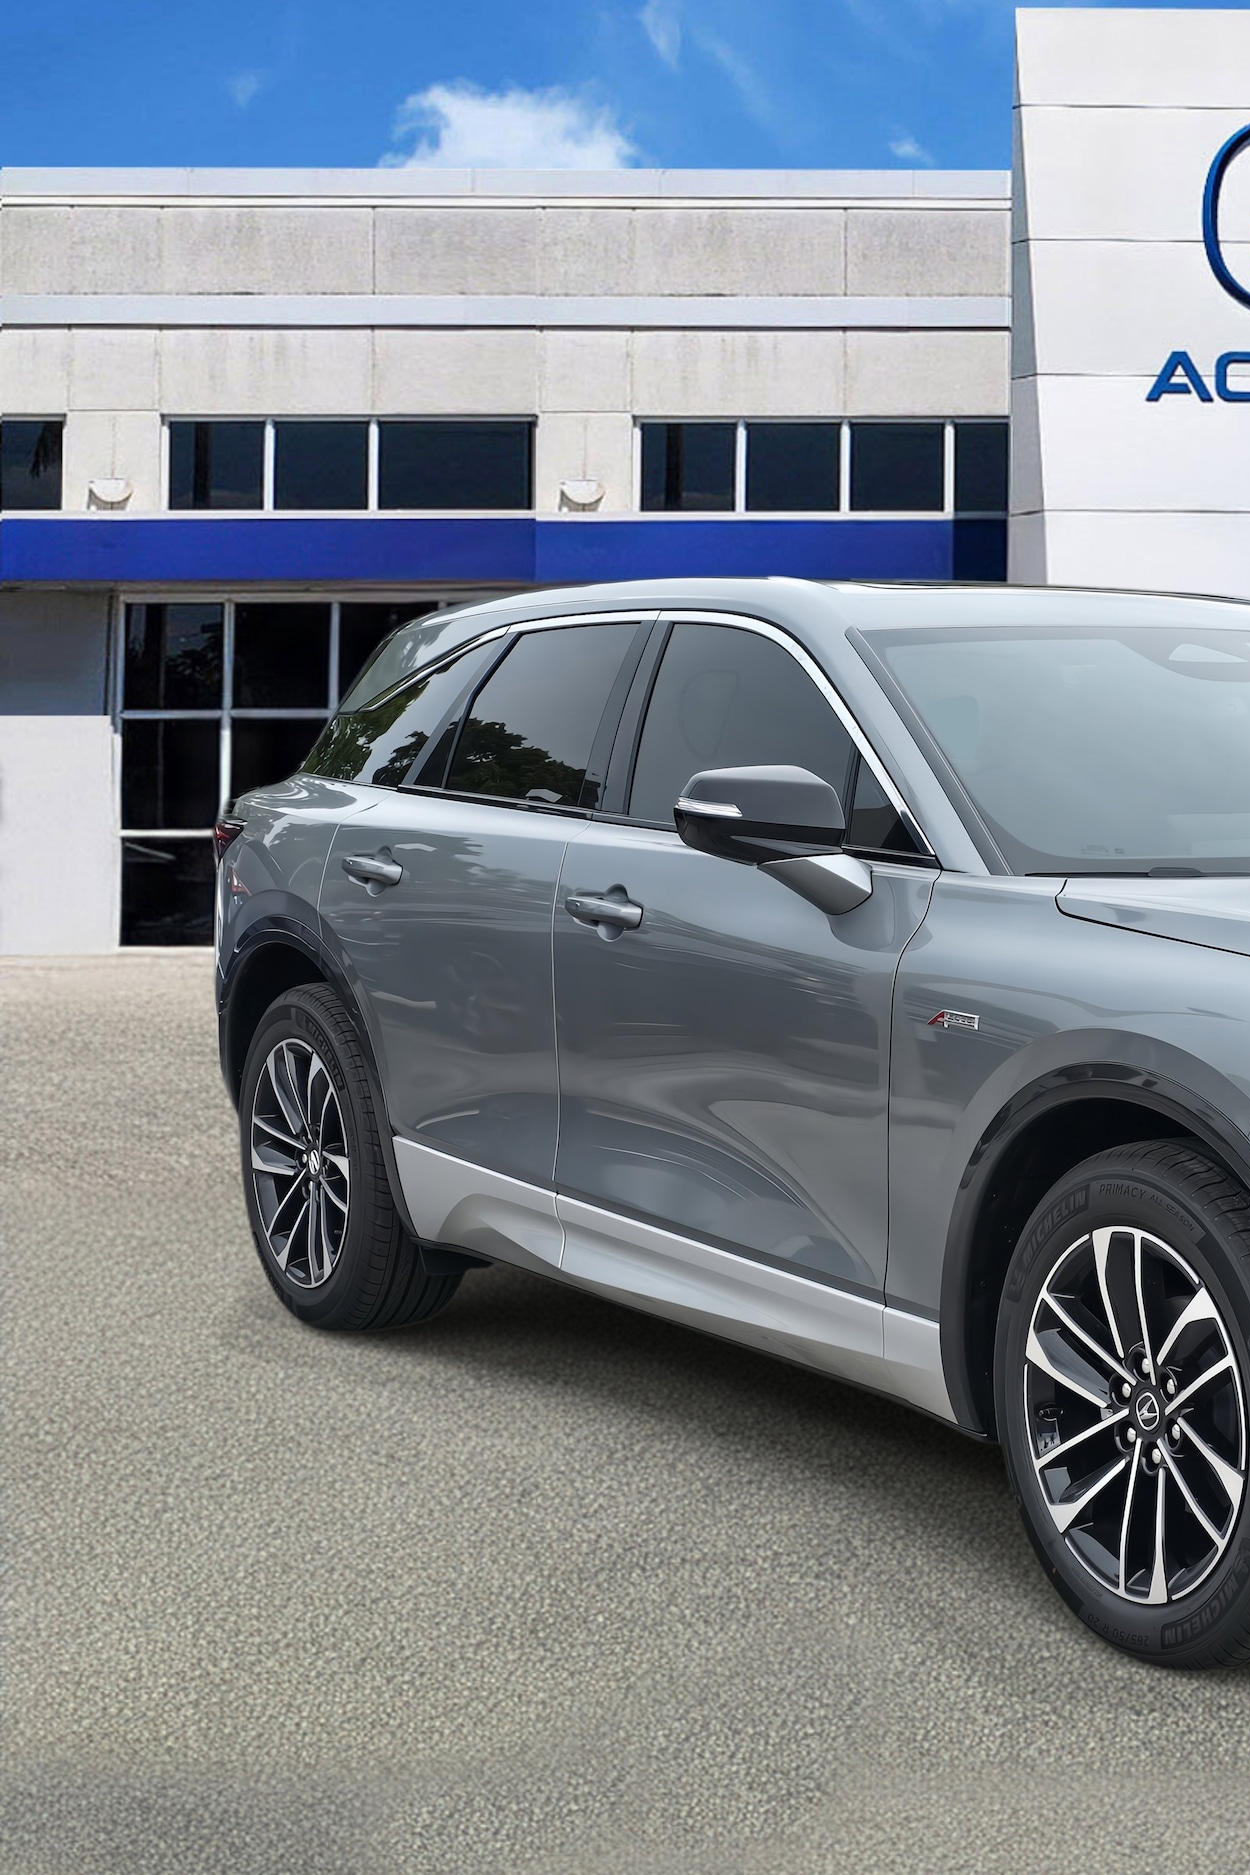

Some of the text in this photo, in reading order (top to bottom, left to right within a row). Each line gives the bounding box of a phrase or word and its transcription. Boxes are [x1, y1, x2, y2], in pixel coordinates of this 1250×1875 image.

[1098, 1182, 1147, 1200] PRIMACY
[1023, 1187, 1088, 1266] MICHELIN
[1164, 1575, 1239, 1645] MICHELIN
